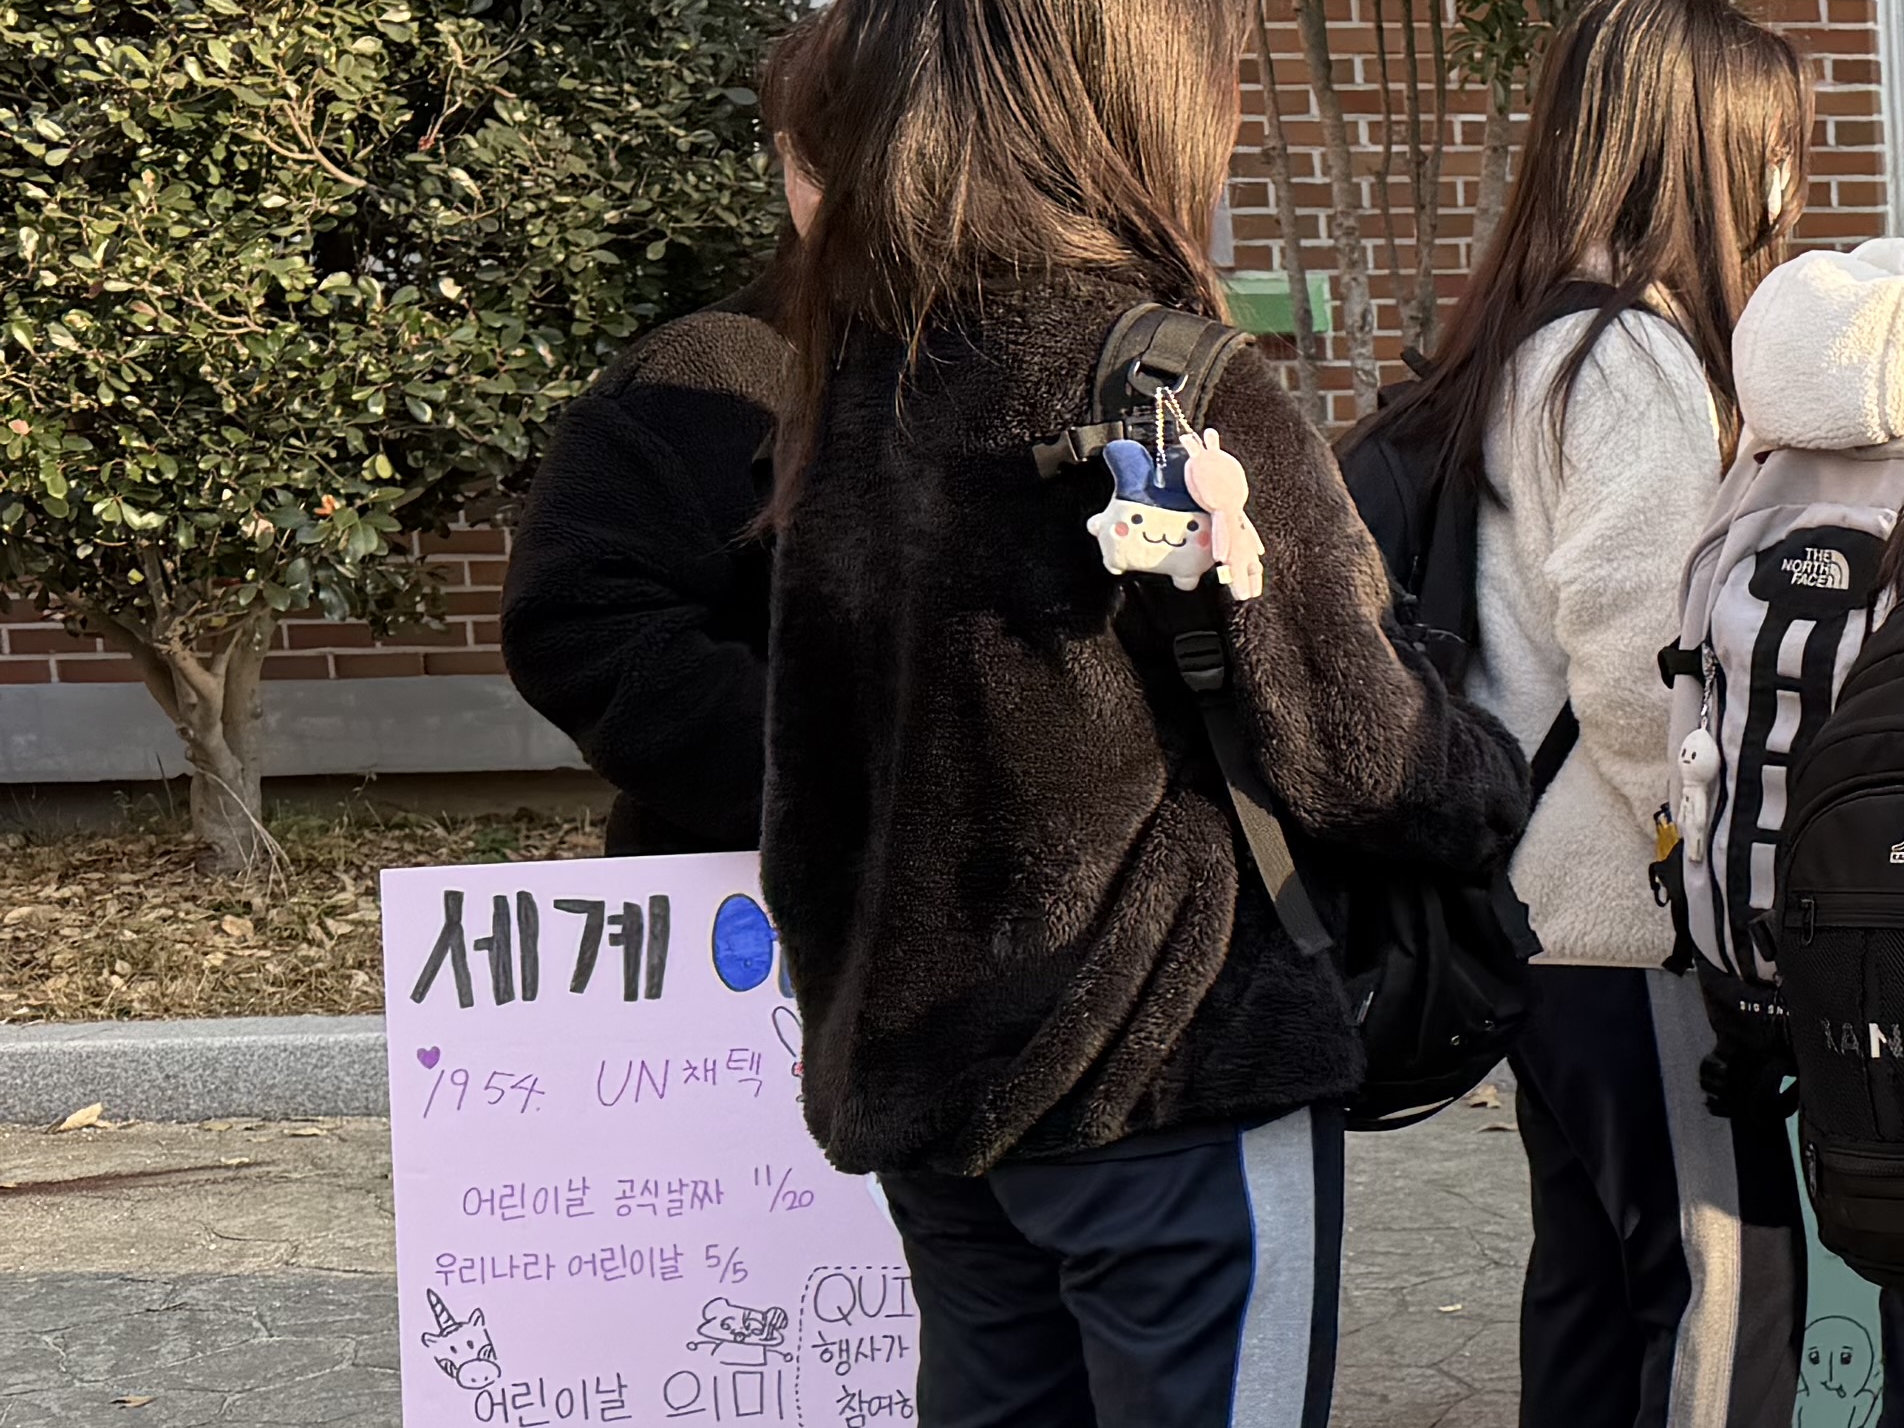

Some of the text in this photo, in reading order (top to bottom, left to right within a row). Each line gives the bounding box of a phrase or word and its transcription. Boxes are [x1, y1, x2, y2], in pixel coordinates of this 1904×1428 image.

[1781, 558, 1829, 575] NORTH
[1804, 547, 1832, 563] THE
[1790, 573, 1827, 588] FACE
[409, 889, 671, 1009] 세계
[462, 1164, 814, 1220] 어린이날 공식날짜 11/20
[435, 1244, 748, 1286] 우리나라 어린이날 5/5
[813, 1273, 914, 1325] QUI
[475, 1370, 784, 1428] 어린이날 의미
